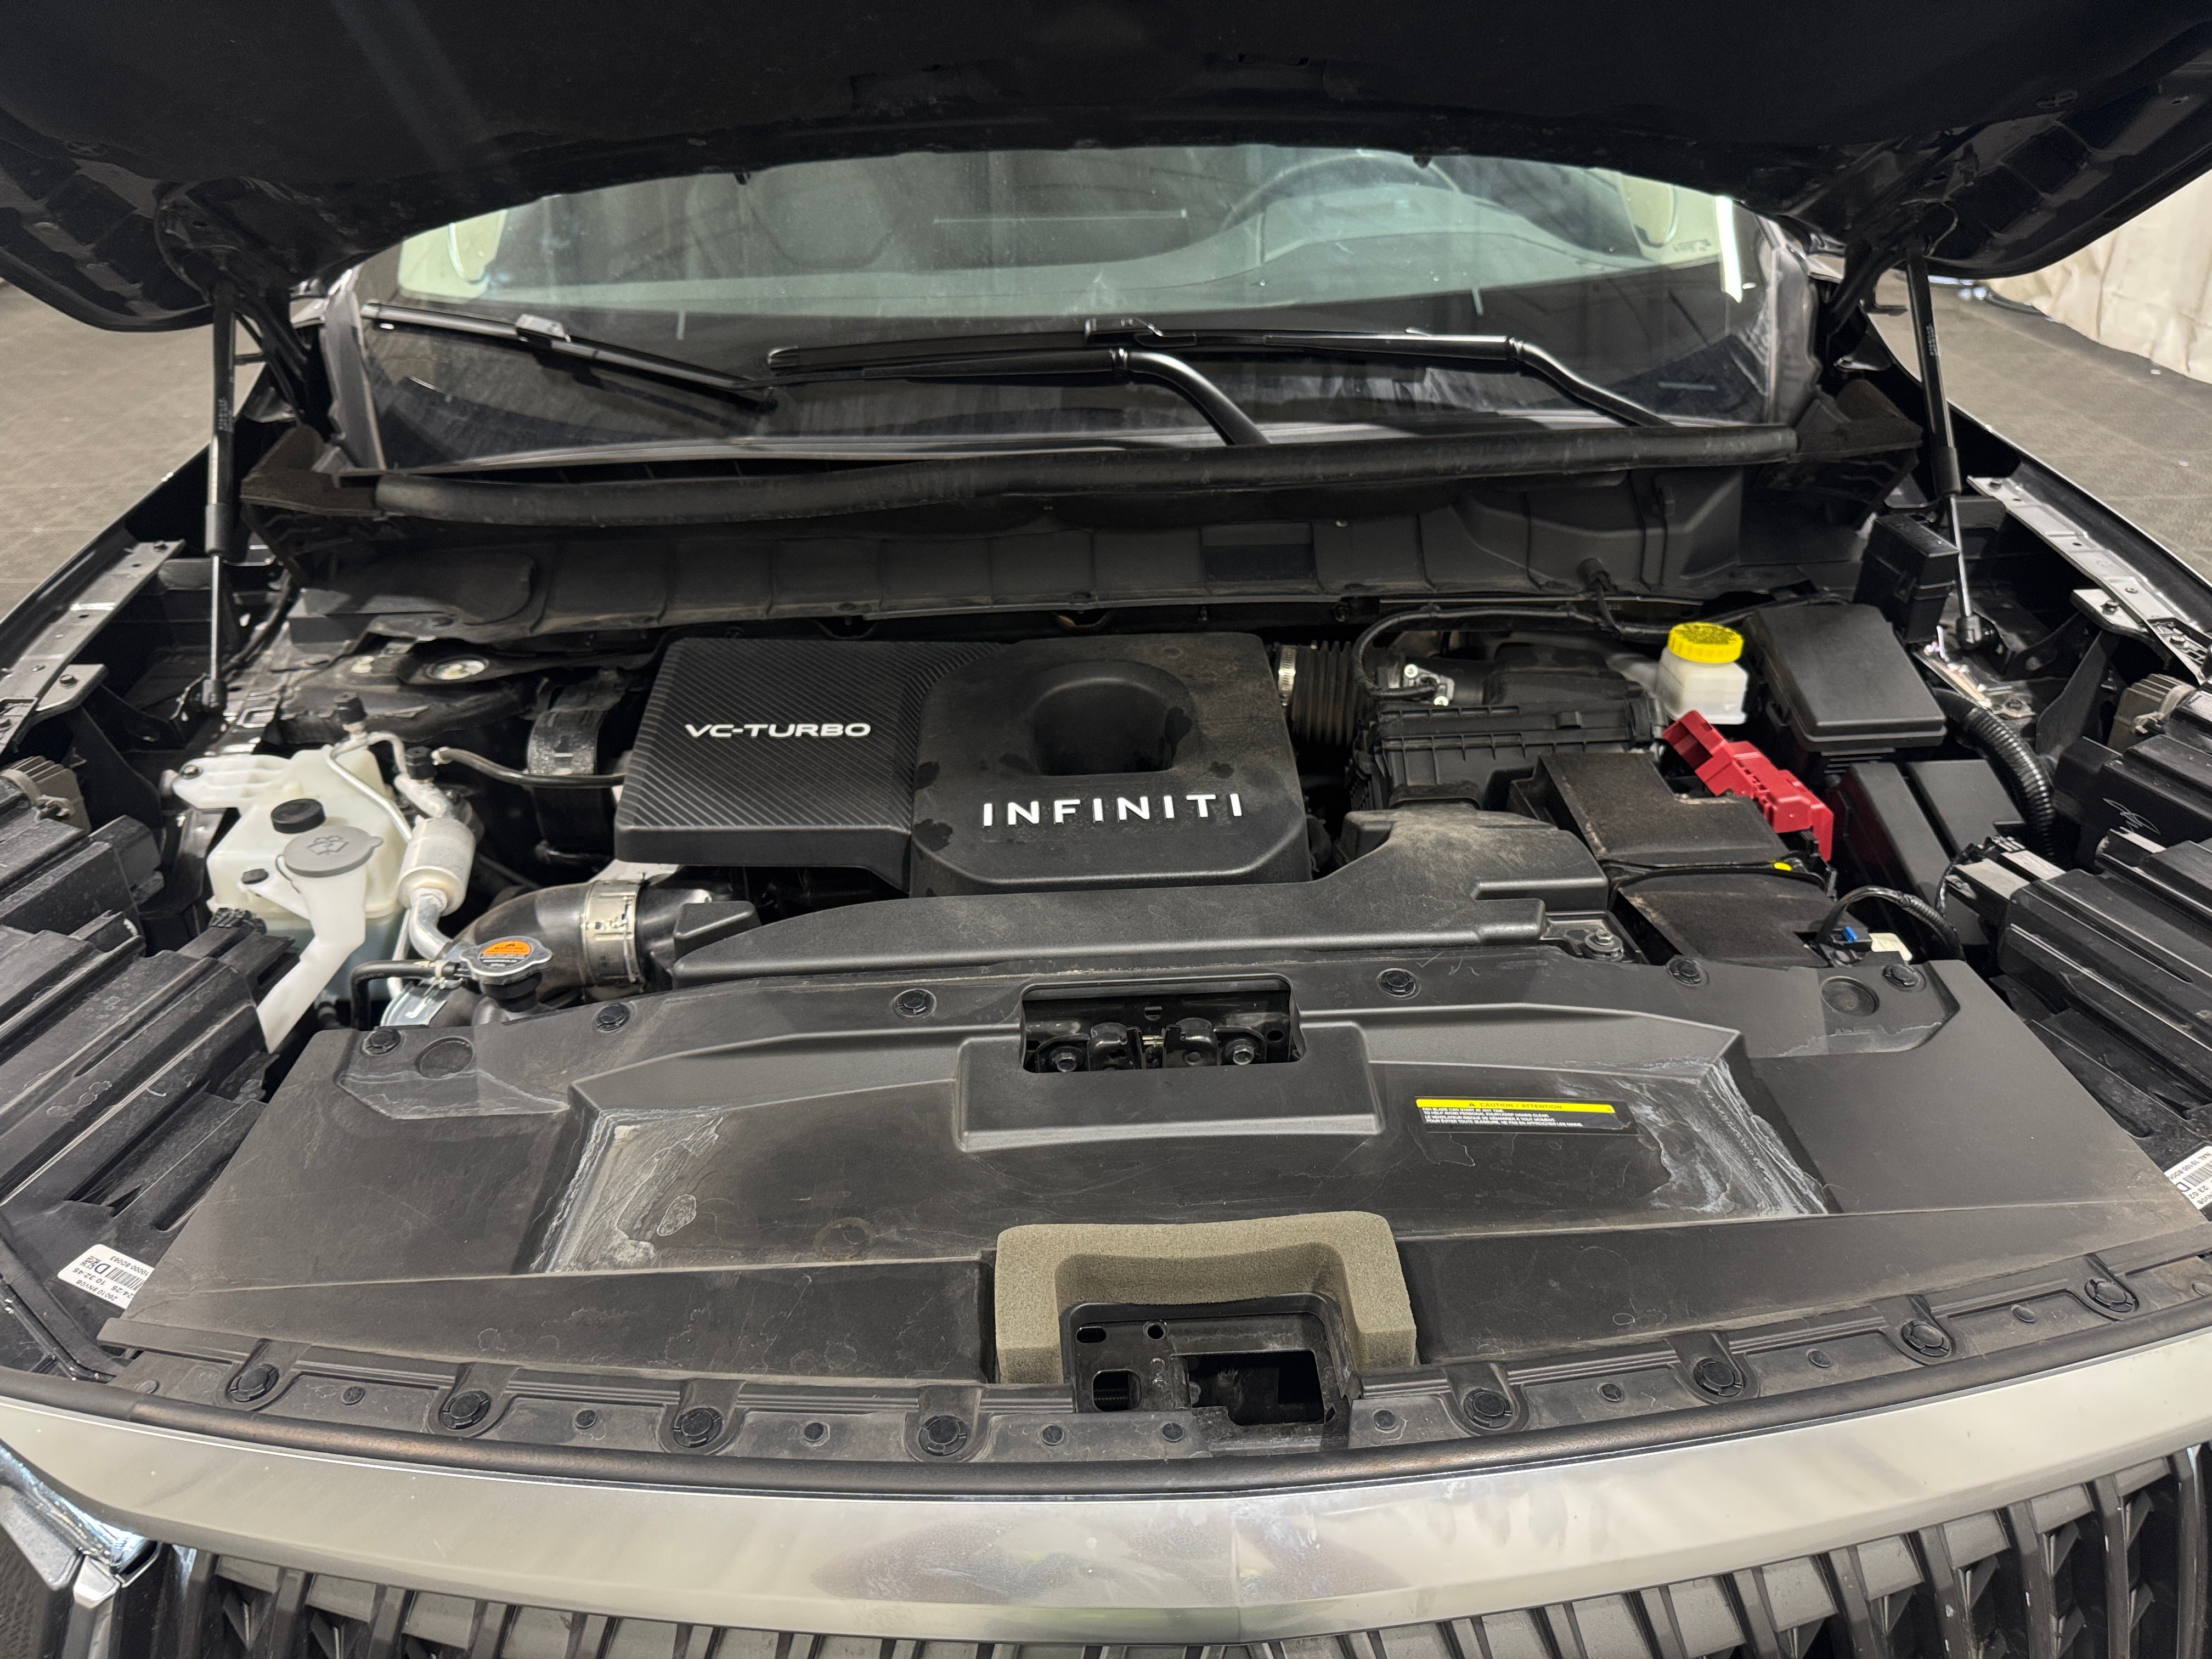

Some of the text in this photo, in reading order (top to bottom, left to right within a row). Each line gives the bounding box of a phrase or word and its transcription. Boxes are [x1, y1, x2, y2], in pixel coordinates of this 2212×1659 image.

[684, 722, 872, 738] VC-TURBO
[983, 792, 1243, 827] INFINITI
[2197, 1152, 2211, 1160] NAL
[2176, 1181, 2192, 1192] D
[94, 1263, 111, 1274] D
